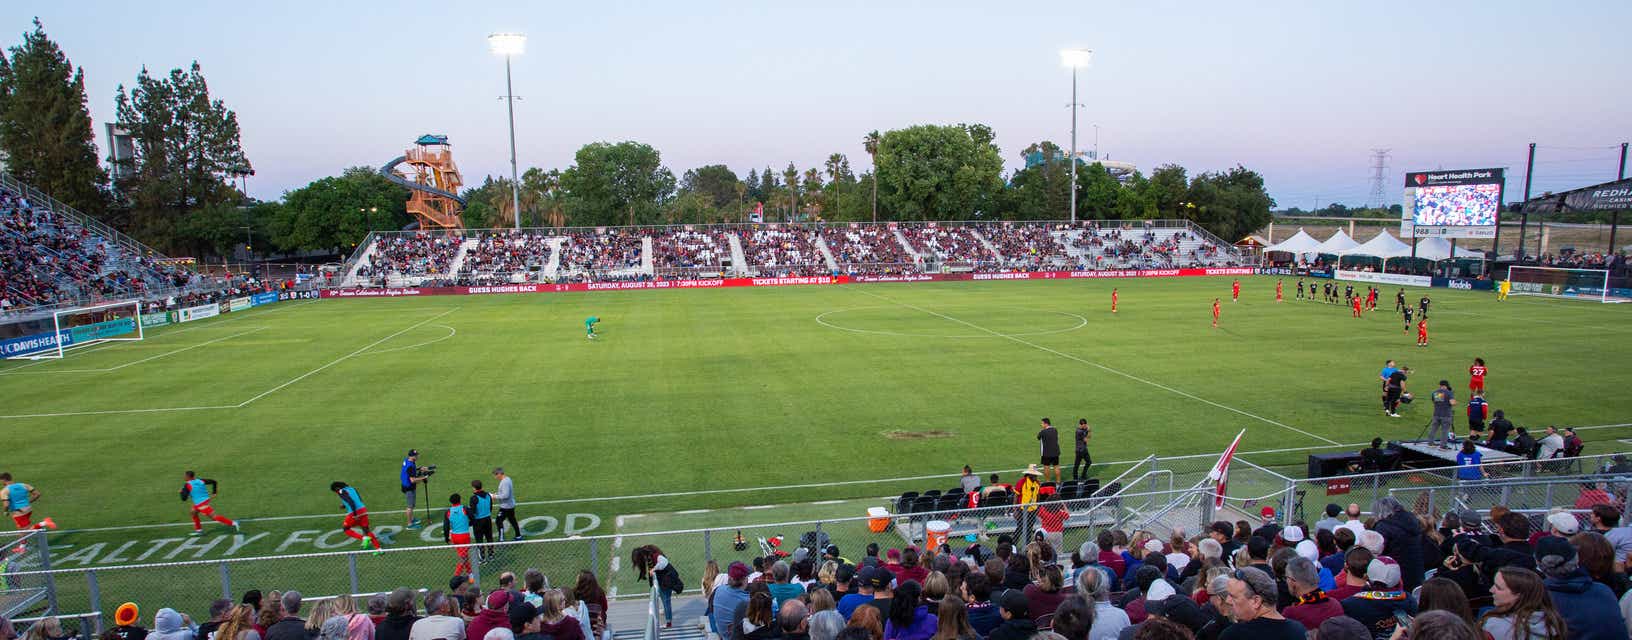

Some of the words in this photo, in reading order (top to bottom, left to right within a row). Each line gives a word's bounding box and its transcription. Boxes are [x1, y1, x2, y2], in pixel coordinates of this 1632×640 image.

[1428, 173, 1448, 181] Heart
[1449, 172, 1473, 180] Health
[752, 278, 778, 286] TICKETS
[779, 277, 809, 285] STARTING
[1448, 279, 1472, 289] Modelo
[468, 286, 491, 294] GUESS
[13, 338, 39, 352] DAVIS
[38, 333, 71, 348] HEATH
[1472, 368, 1485, 376] 27
